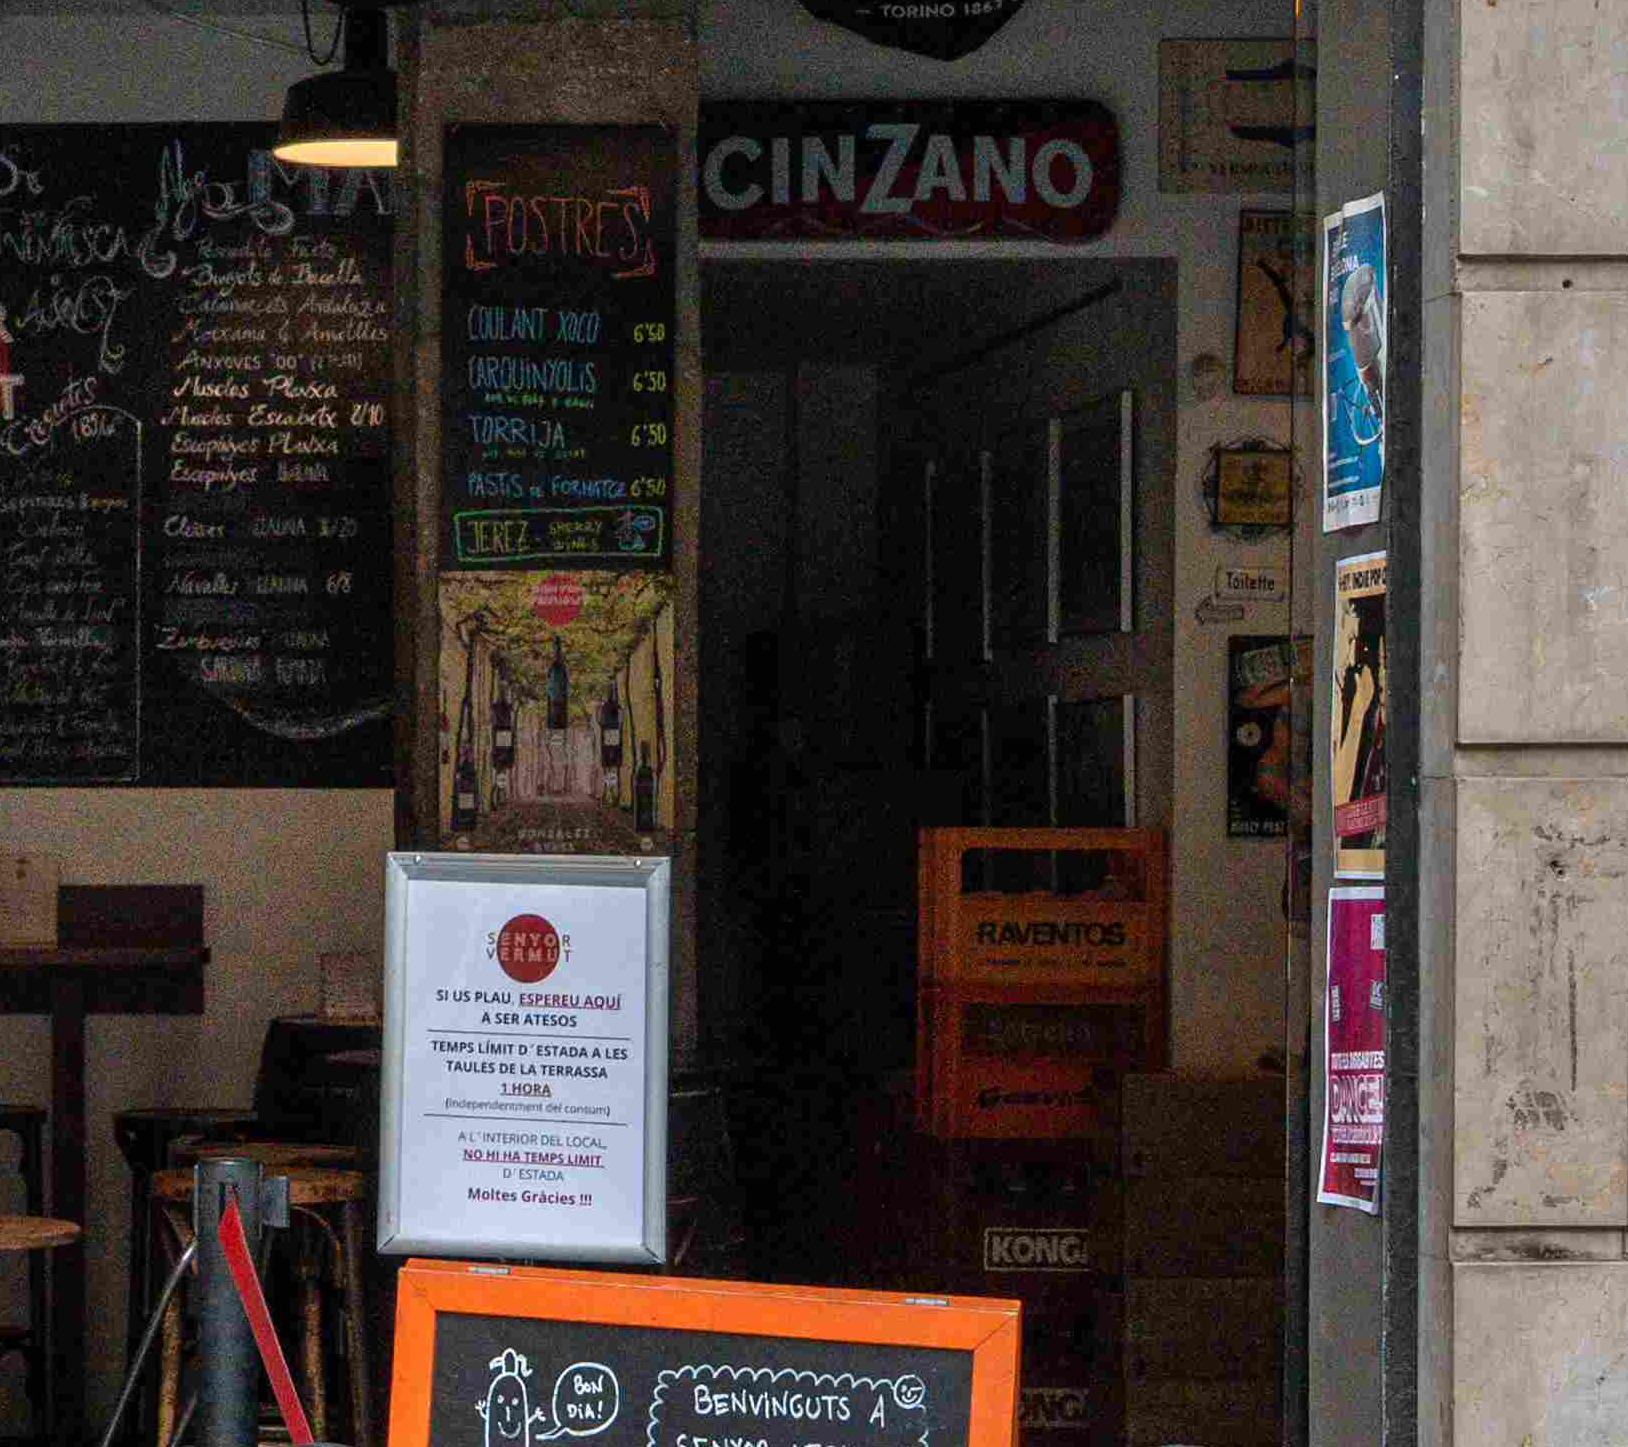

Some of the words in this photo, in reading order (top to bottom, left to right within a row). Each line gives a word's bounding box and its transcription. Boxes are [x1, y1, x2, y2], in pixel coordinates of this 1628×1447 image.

[703, 122, 1095, 215] CINZANO
[483, 194, 640, 261] POSTRES
[436, 988, 450, 1002] SI
[452, 989, 471, 1003] US
[519, 992, 580, 1008] ESPEREU
[583, 993, 622, 1010] AQUÍ
[494, 1012, 520, 1026] SER
[523, 1013, 578, 1028] ATESOS
[431, 1040, 475, 1054] TEMPS
[605, 1047, 628, 1061] LES
[445, 1060, 496, 1074] TAULES
[539, 1064, 608, 1080] TERRASSA
[990, 1235, 1084, 1267] KONG
[572, 1374, 604, 1396] BON
[869, 1395, 886, 1429] A
